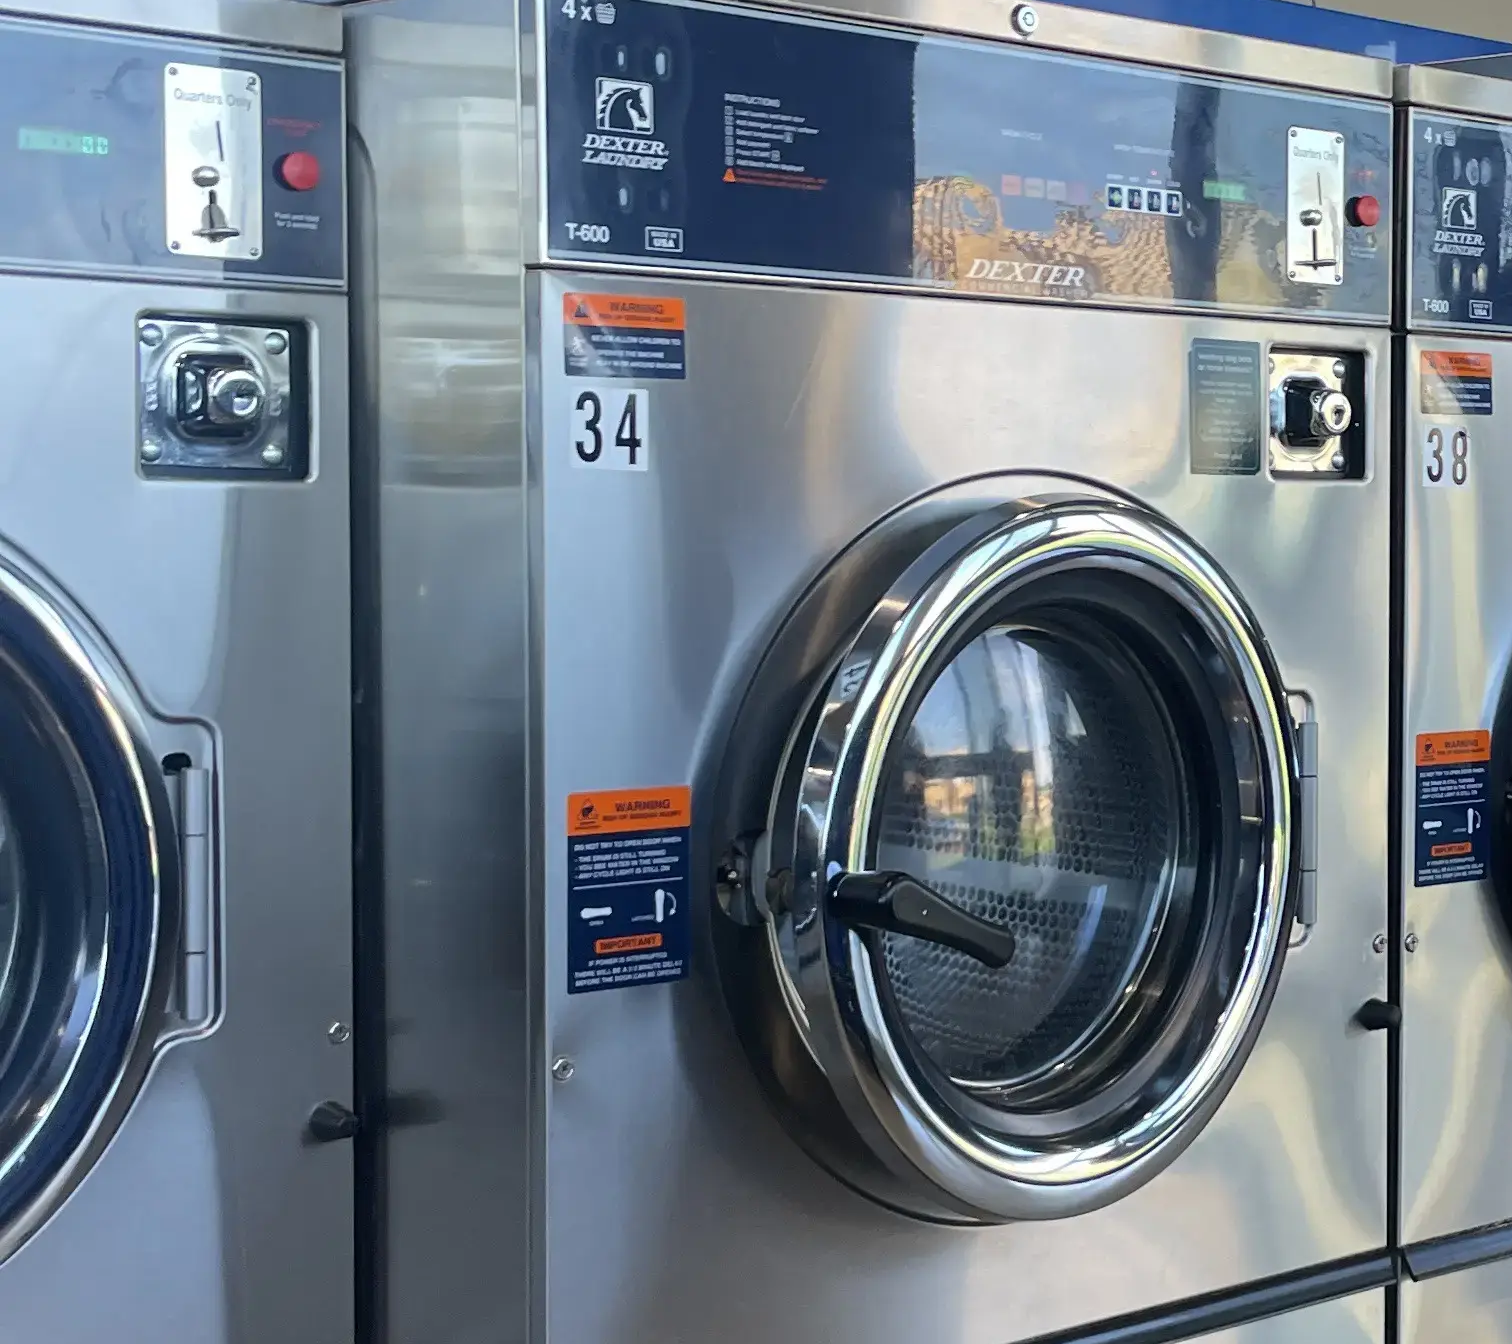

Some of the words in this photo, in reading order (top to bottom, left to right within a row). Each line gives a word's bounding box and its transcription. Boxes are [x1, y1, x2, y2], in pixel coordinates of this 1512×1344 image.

[174, 88, 222, 105] Quarters
[226, 94, 252, 111] Only
[582, 133, 667, 155] DEXTER
[565, 222, 610, 243] T-600
[1434, 230, 1484, 246] DEXTER
[966, 258, 1085, 286] DEXTER
[575, 391, 642, 466] 34
[1427, 428, 1468, 485] 38
[615, 798, 670, 812] WARNING
[600, 936, 657, 950] IMPORTANT
